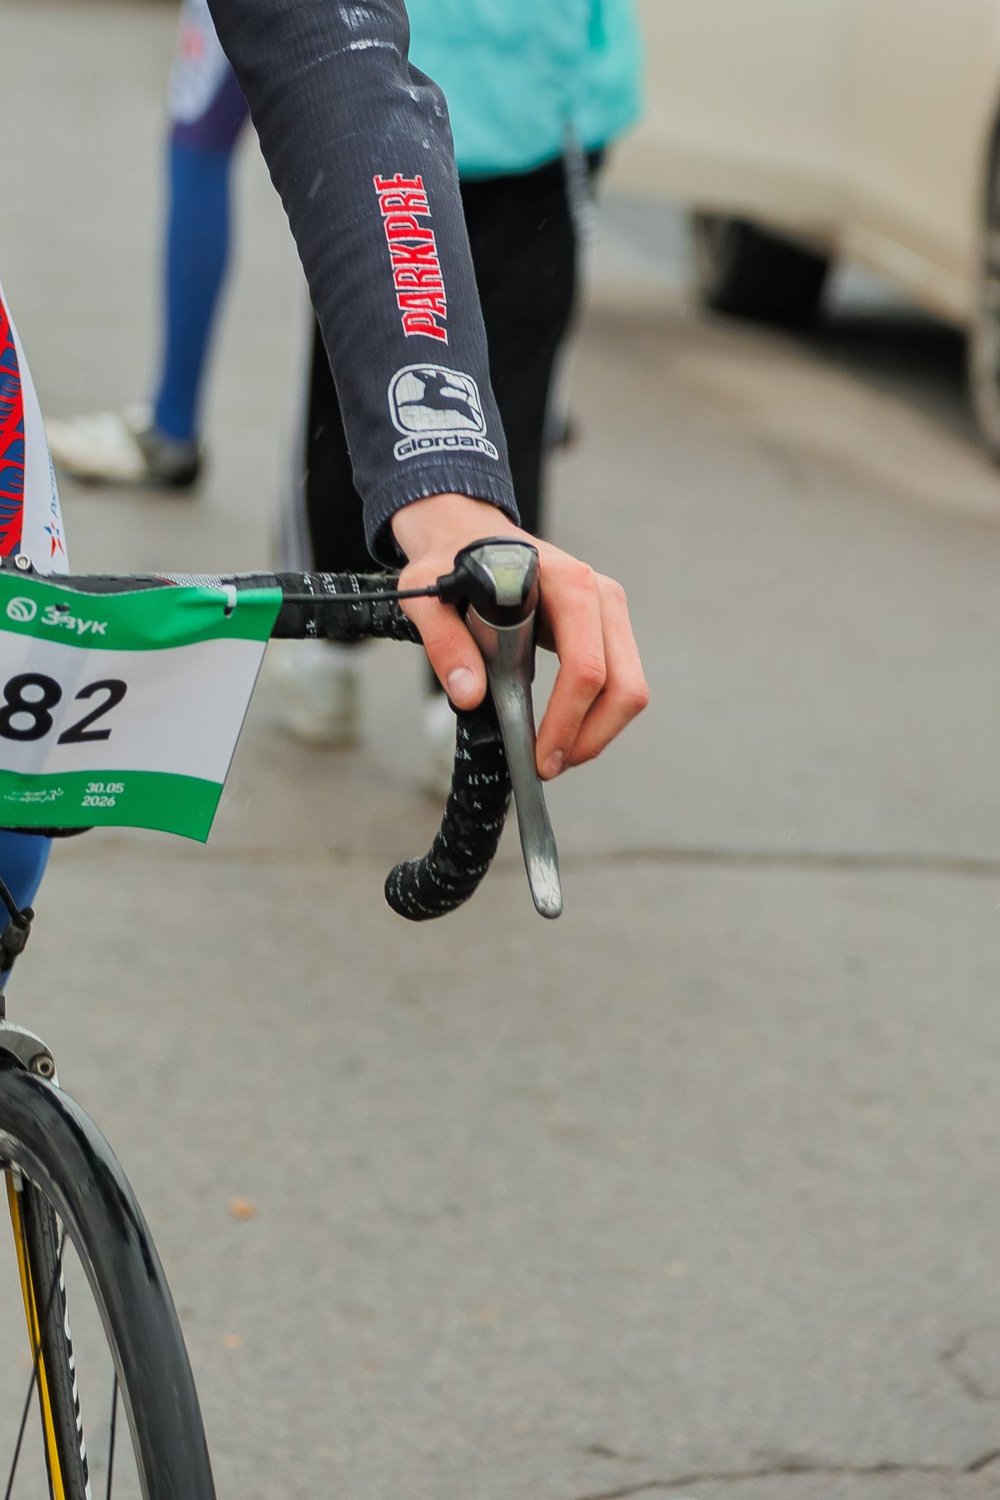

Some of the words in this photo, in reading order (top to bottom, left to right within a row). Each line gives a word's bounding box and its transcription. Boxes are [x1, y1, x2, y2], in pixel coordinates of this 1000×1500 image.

[372, 172, 449, 346] PARKPRE
[85, 782, 125, 794] 30.05
[81, 795, 116, 807] 2026
